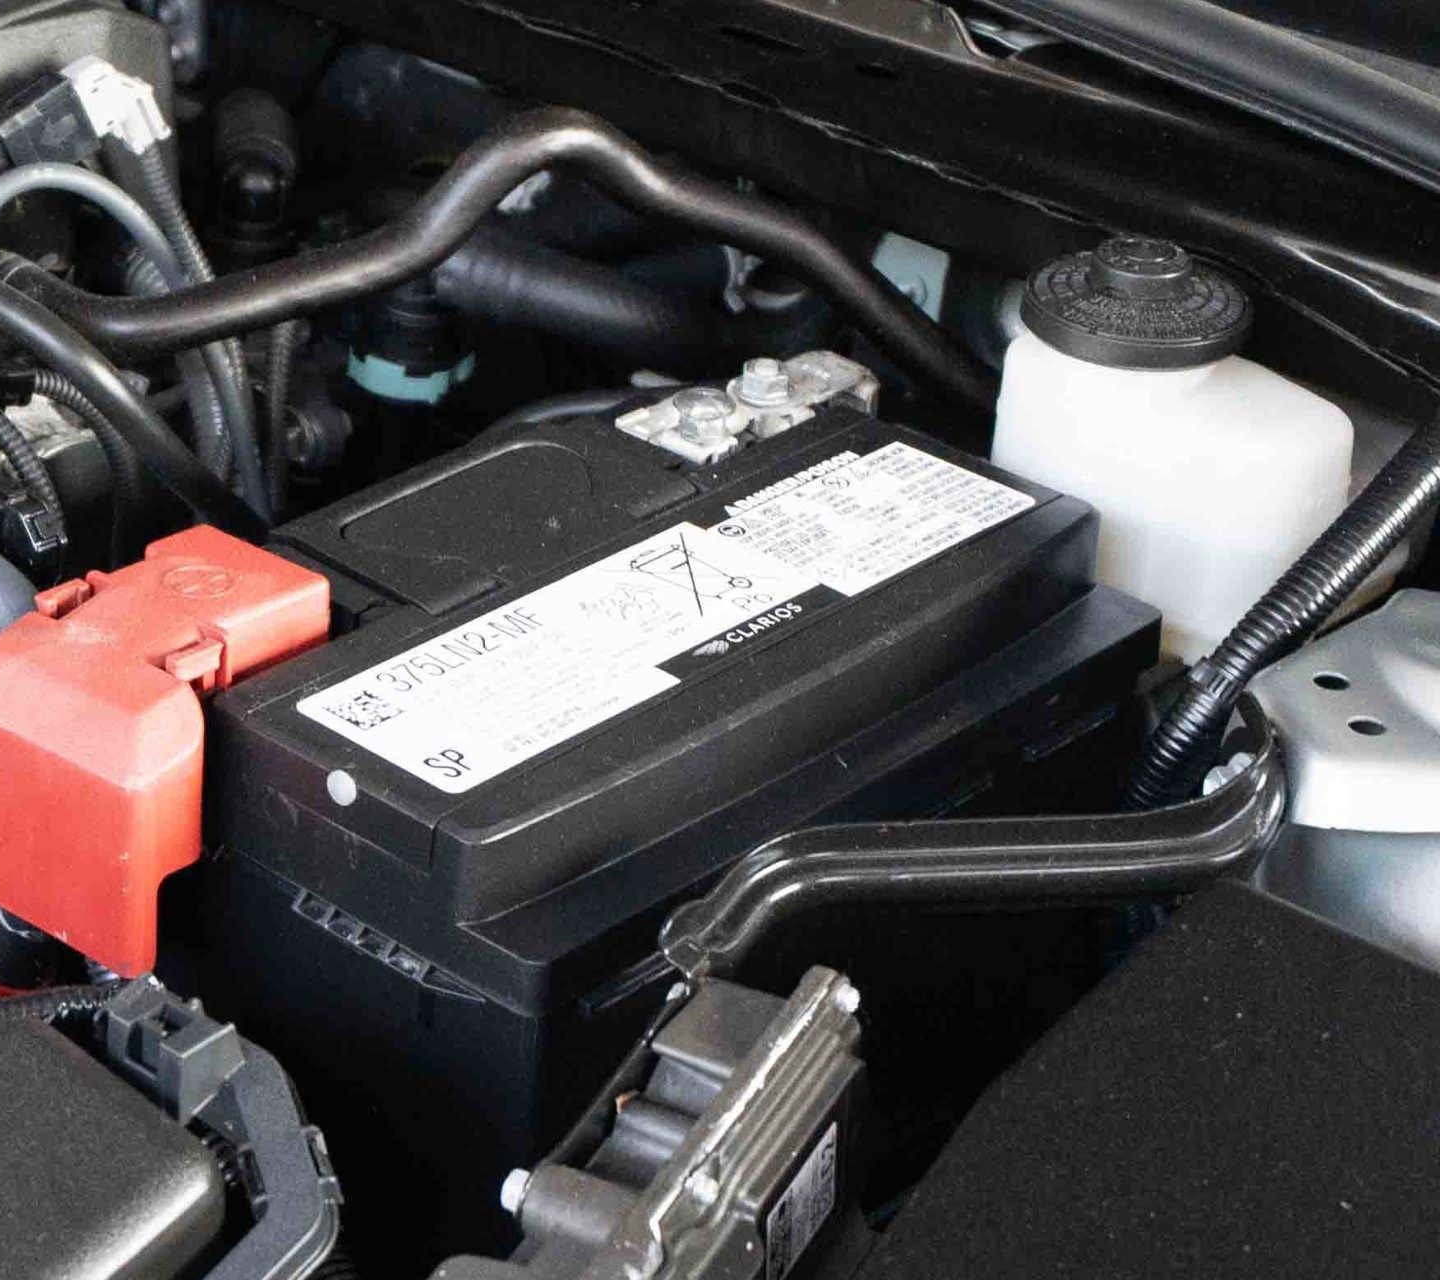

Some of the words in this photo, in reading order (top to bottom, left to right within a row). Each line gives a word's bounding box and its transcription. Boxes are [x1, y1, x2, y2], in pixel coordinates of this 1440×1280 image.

[725, 601, 803, 644] CLARIOS
[376, 606, 543, 693] 375LN2-MF
[422, 748, 472, 778] SP
